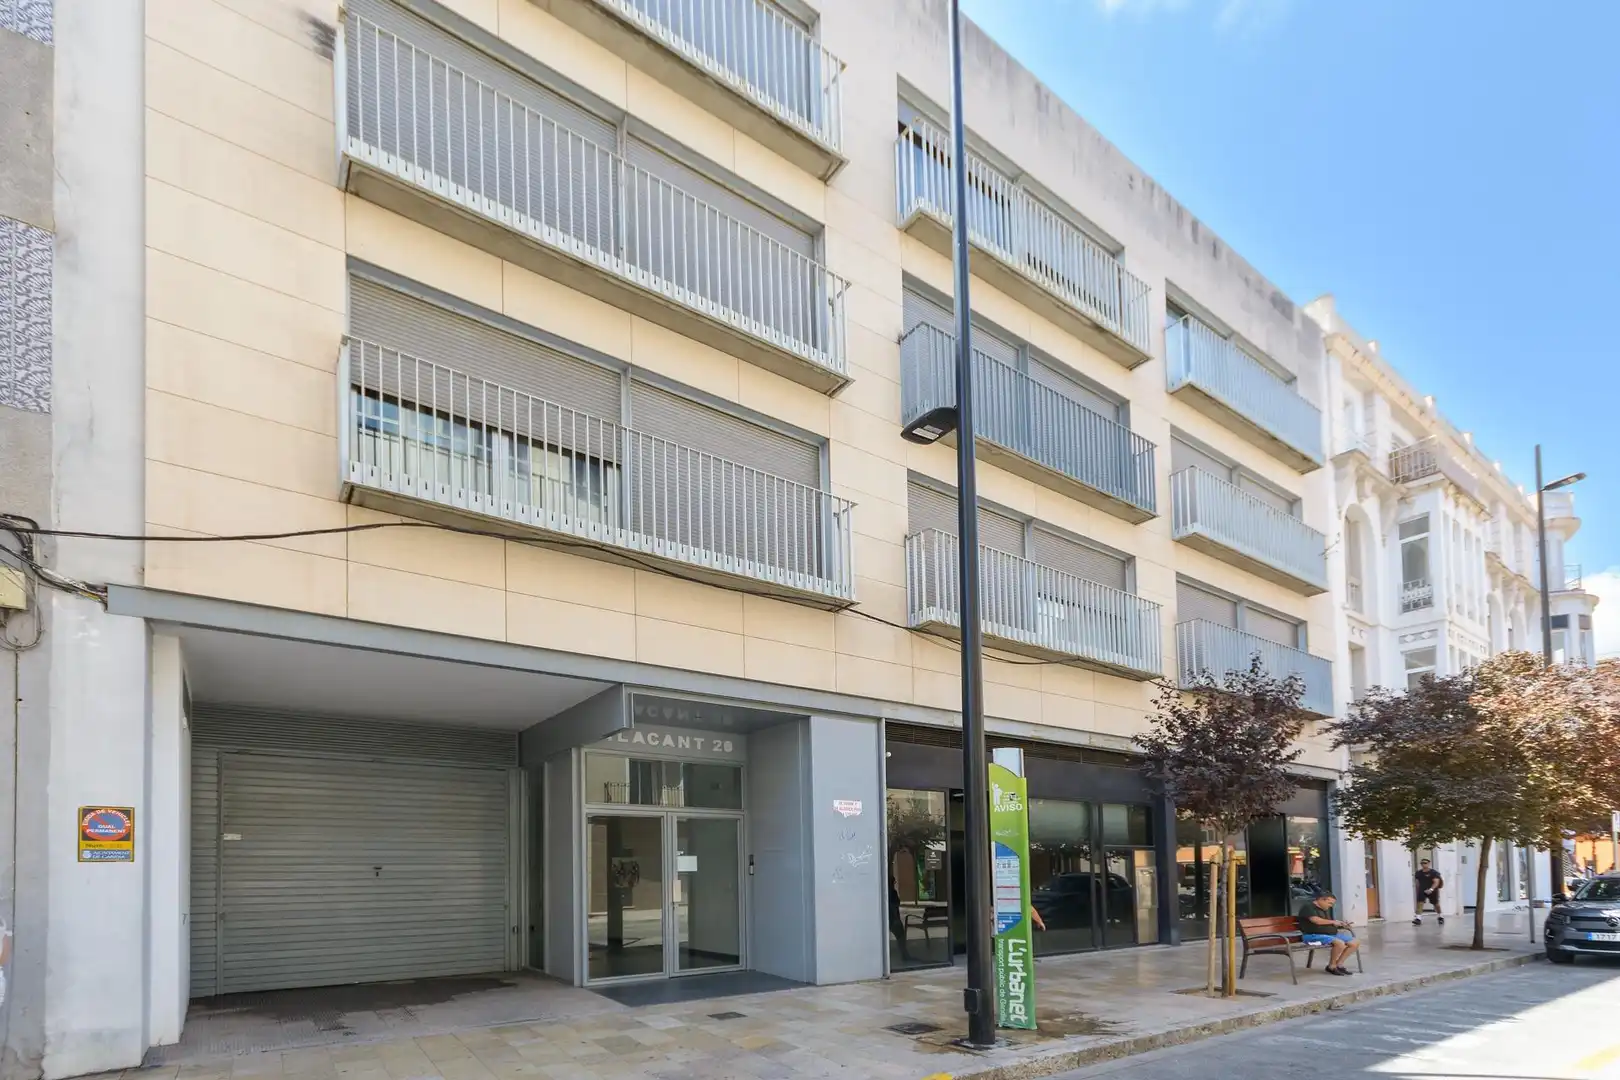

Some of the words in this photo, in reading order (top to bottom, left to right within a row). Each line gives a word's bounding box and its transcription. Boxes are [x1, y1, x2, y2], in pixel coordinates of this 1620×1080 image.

[607, 731, 705, 750] LACANT
[994, 803, 1023, 812] AVISO
[1008, 938, 1028, 1025] L'urbanet
